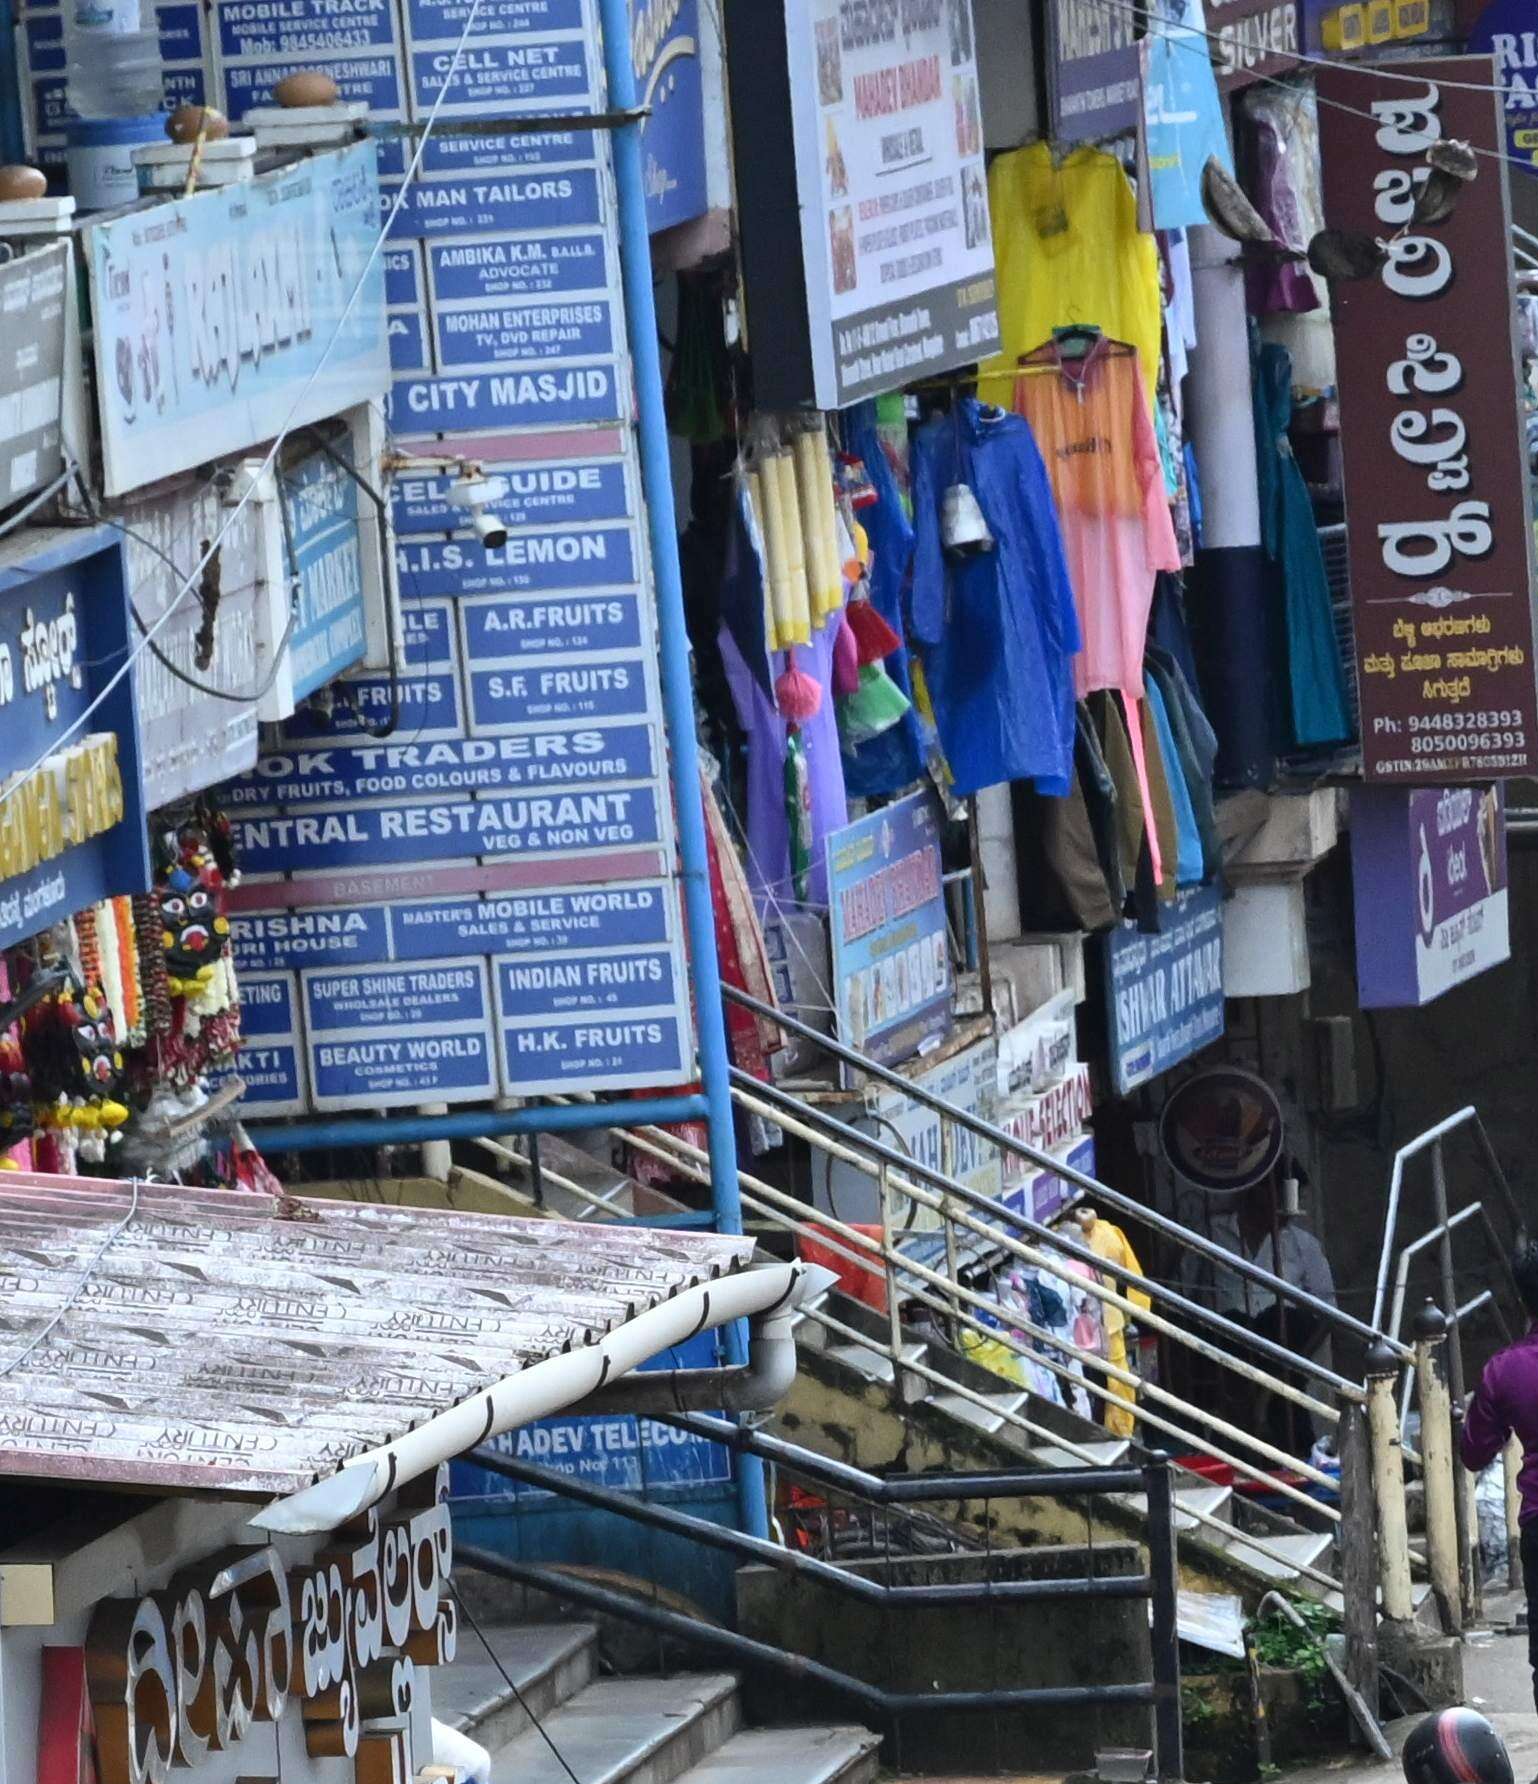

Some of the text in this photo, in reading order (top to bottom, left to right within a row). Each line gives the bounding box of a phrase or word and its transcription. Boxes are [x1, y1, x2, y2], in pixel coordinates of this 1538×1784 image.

[223, 0, 302, 22] MOBILE
[433, 47, 559, 72] CELL NET
[477, 69, 529, 84] SERVICE
[532, 64, 582, 80] CENTRE
[439, 131, 574, 154] SERVICE CENTRE
[417, 180, 573, 208] MAN TAILORS
[440, 246, 504, 267] AMBIKA
[510, 243, 548, 260] K.M.
[478, 263, 560, 280] ADVOCATE
[446, 305, 602, 332] MOHAN ENTERPRISES
[476, 327, 582, 347] TV, DVD REPAIR
[408, 370, 608, 413] CITY MASJID
[486, 535, 606, 567] LEMON
[484, 602, 623, 632] A.R.FRUITS
[541, 669, 630, 694] FRUITS
[1373, 709, 1523, 734] Ph: 9448328393
[351, 732, 606, 770] TRADERS
[1411, 731, 1526, 755] 8050096393
[233, 758, 627, 802] DRY FRUITS, FOOD COLOURS & FLAVOURS
[381, 793, 632, 838] RESTAURANT
[483, 824, 634, 850] VEG & NON VEG
[334, 874, 434, 898] BASEMENT
[478, 896, 563, 919] MOBILE
[570, 890, 653, 912] WORLD
[230, 912, 368, 942] RISHNA
[531, 915, 599, 931] SERVICE
[280, 935, 358, 953] HOUSE
[313, 970, 475, 1000] SUPER SHINE TRADERS
[509, 958, 662, 990] INDIAN FRUITS
[518, 1024, 662, 1052] H.K. FRUITS
[320, 1037, 481, 1067] BEAUTY WORLD
[231, 1297, 348, 1321] CENTURY
[387, 1310, 501, 1332] CENTURY
[156, 1426, 278, 1451] CENTURY
